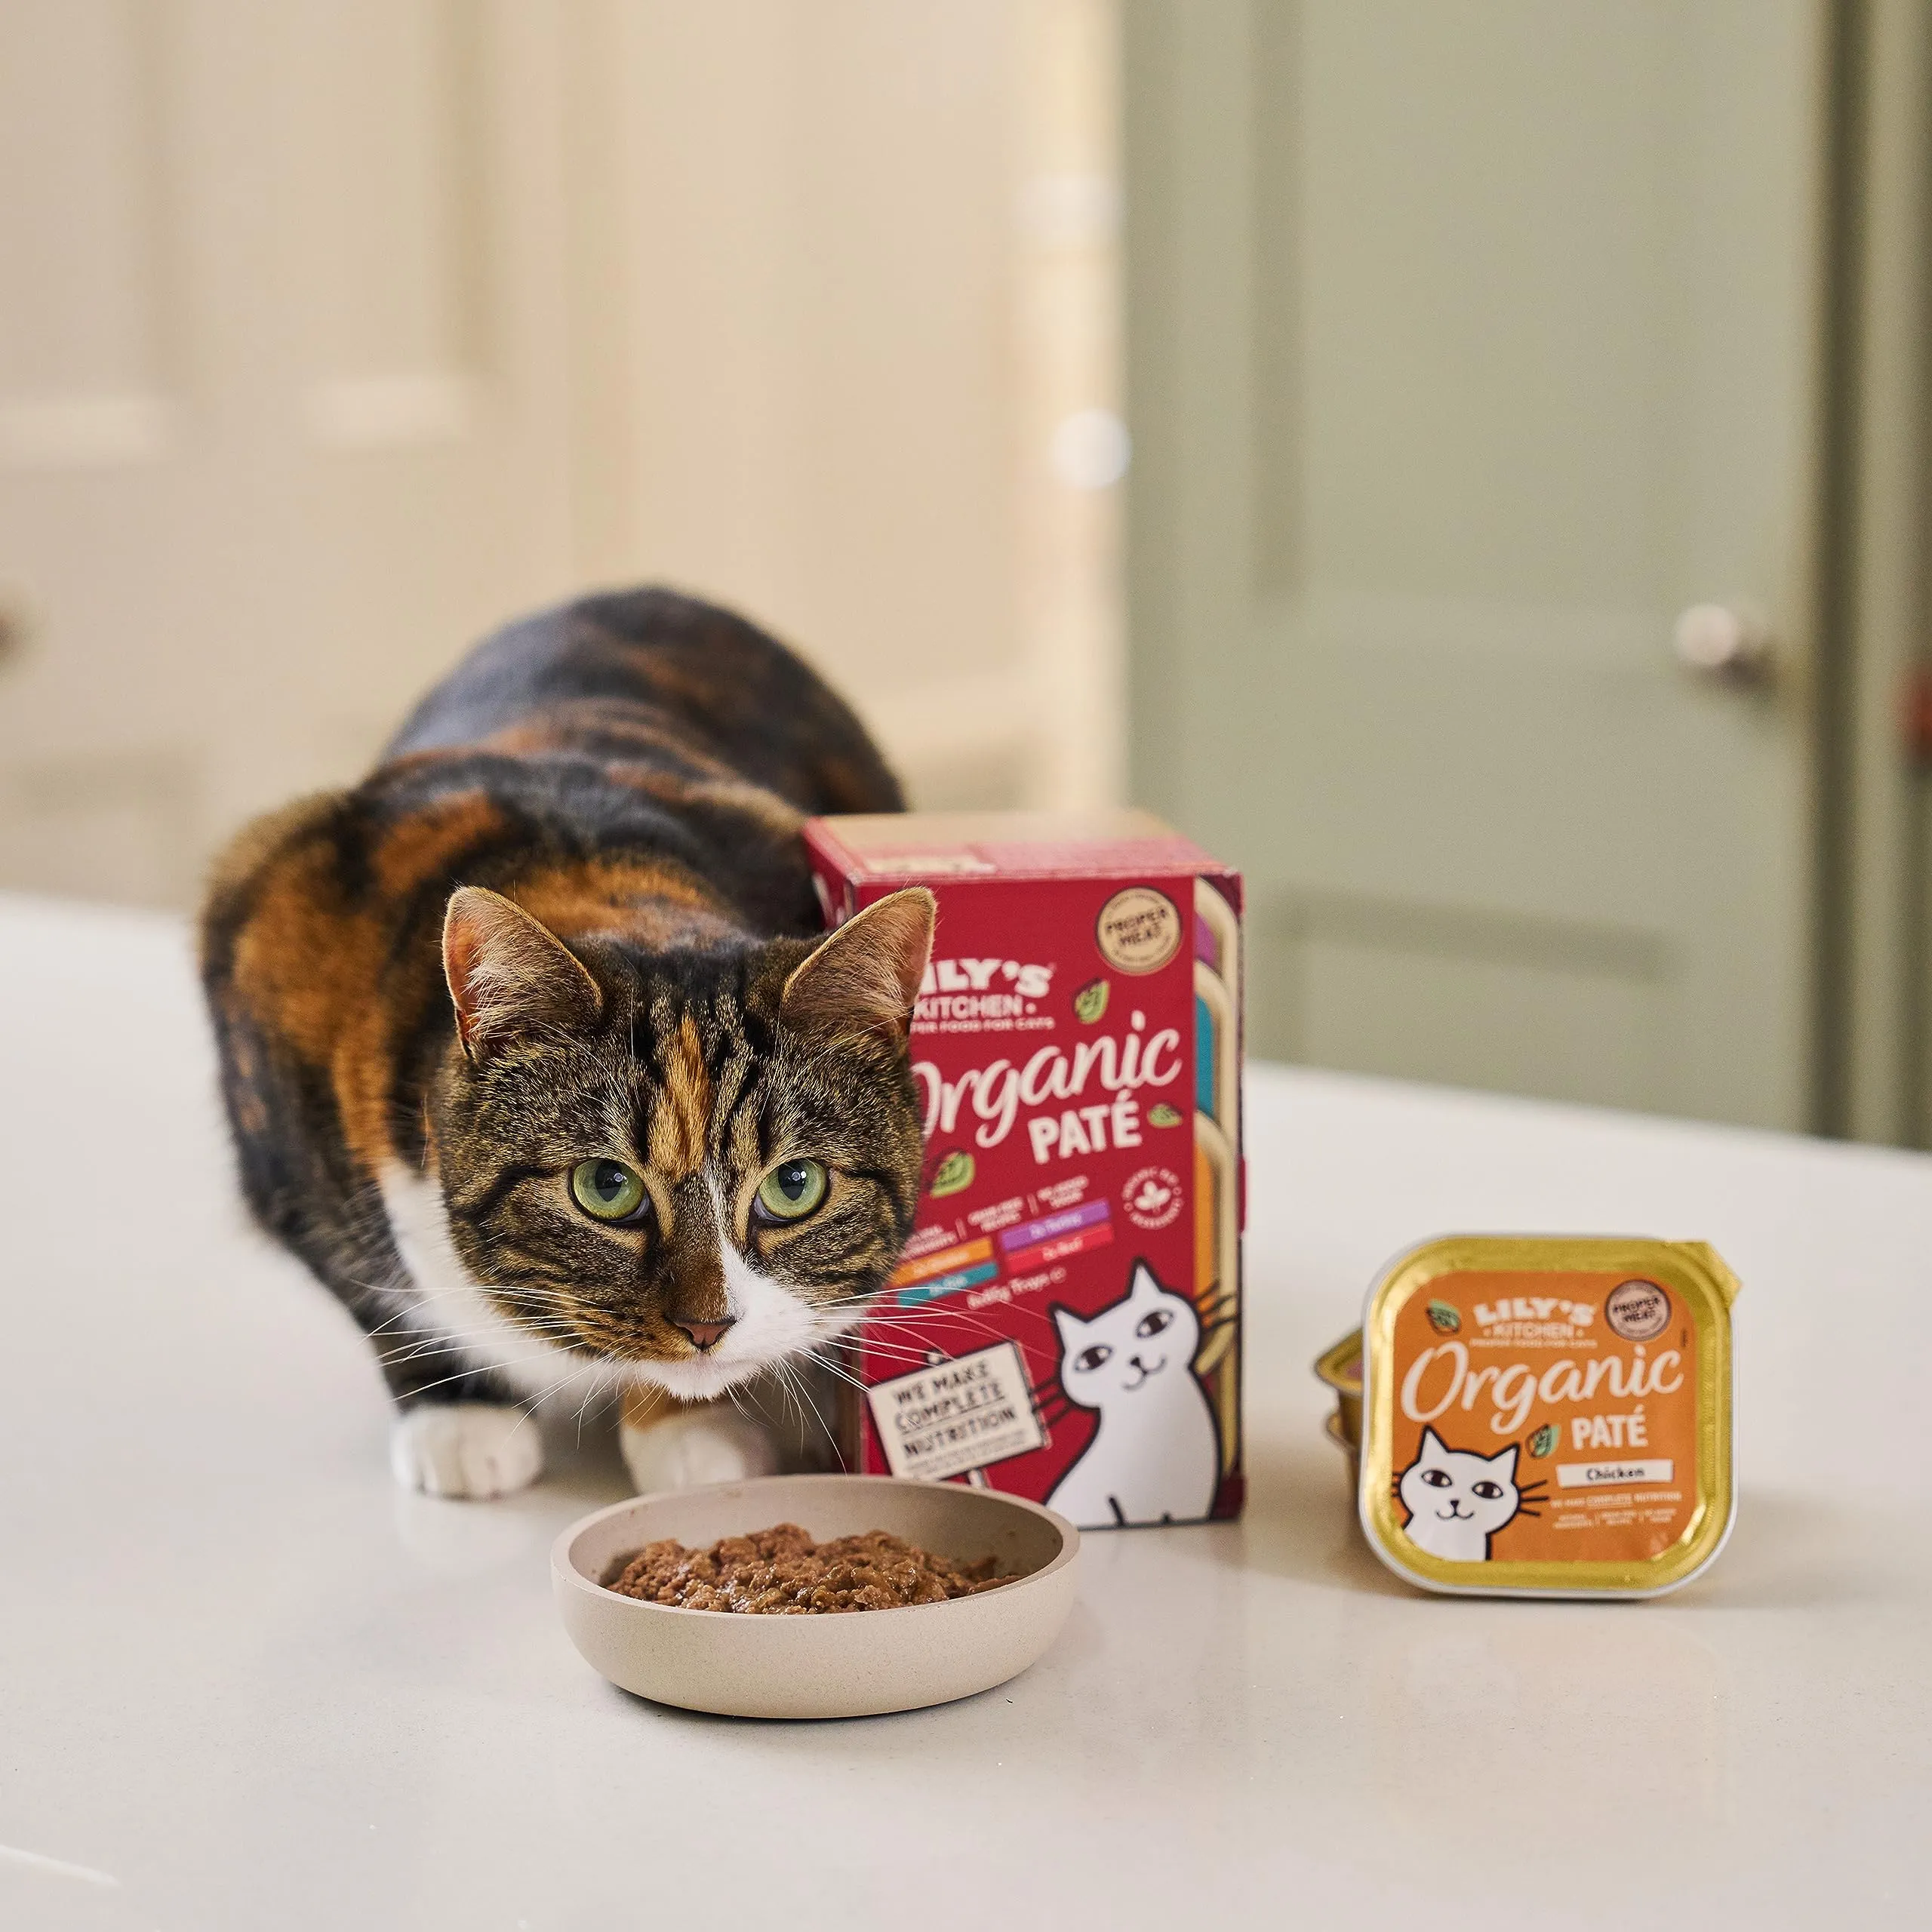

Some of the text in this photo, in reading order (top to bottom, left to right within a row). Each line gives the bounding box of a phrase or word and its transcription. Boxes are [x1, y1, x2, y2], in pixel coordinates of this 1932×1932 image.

[918, 958, 1054, 998] ILY'S
[1027, 1091, 1143, 1165] PATÉ
[1473, 1297, 1595, 1327] LILY'S
[1492, 1321, 1575, 1338] KITCHEN
[894, 1359, 989, 1404] WE MAKE
[895, 1380, 1004, 1429] COMPLETE
[1400, 1340, 1684, 1435] Organic
[903, 1407, 1017, 1455] NUTRITION
[1571, 1404, 1648, 1451] PATÉ
[1586, 1466, 1645, 1481] Chicken
